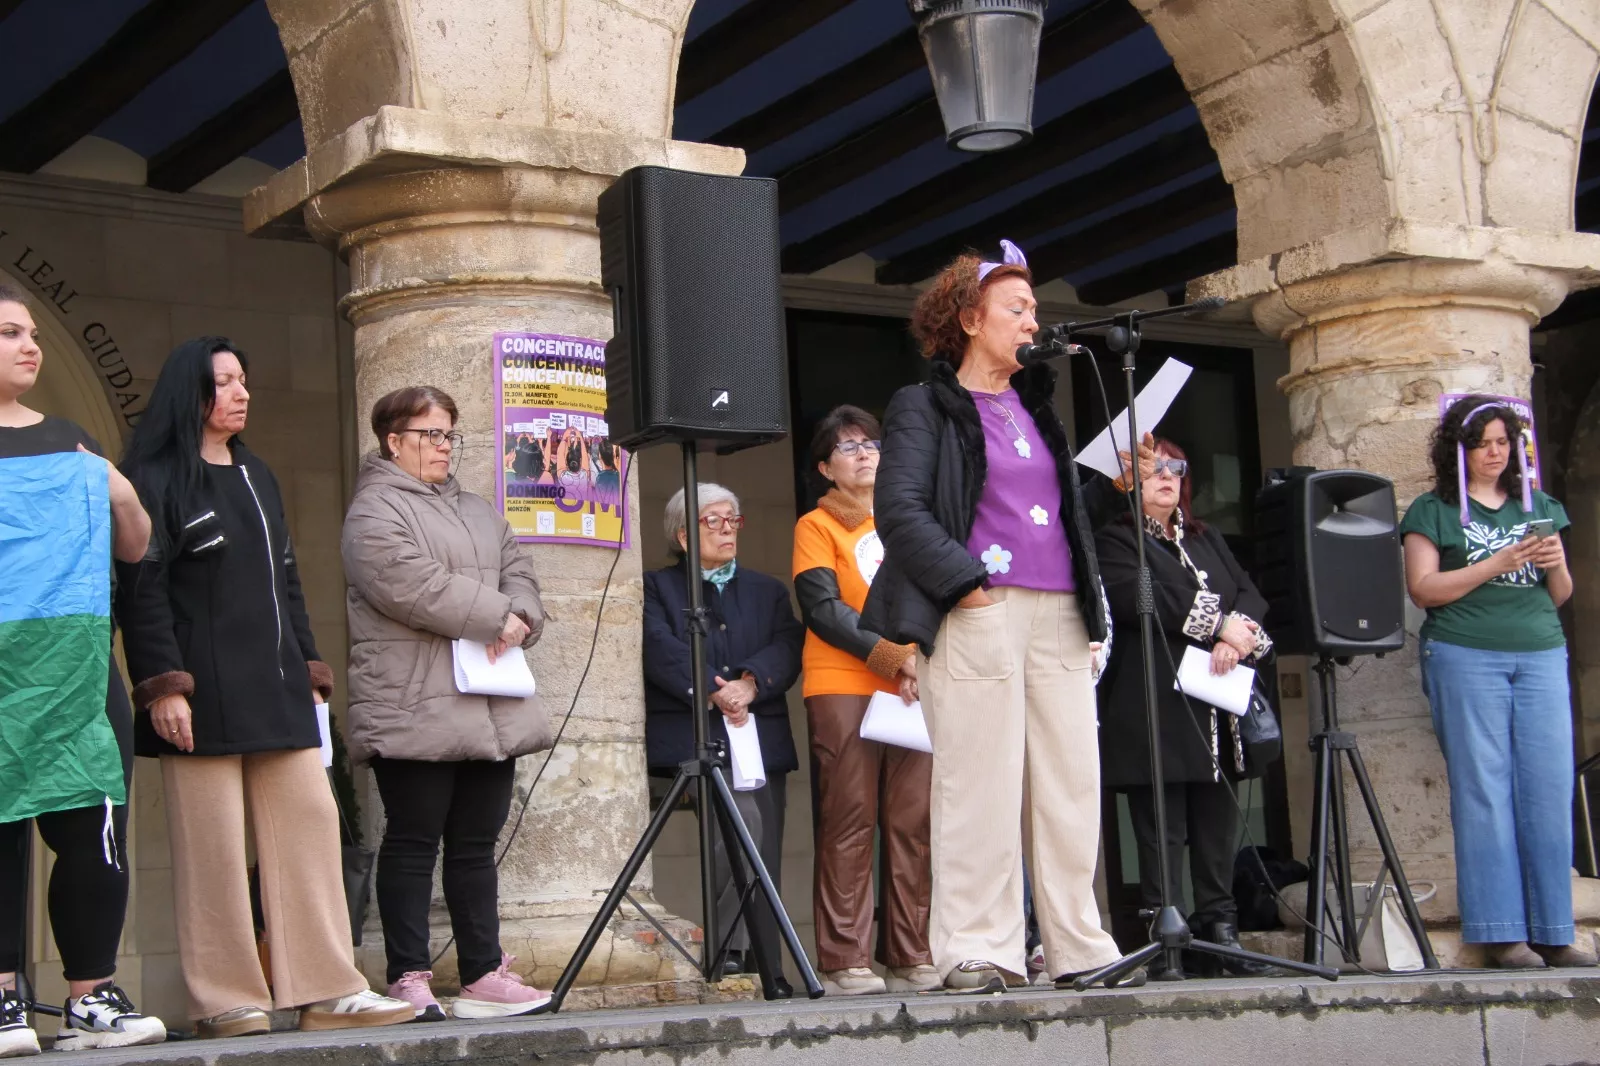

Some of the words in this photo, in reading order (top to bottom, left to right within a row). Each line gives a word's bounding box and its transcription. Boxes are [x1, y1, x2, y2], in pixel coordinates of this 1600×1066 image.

[13, 246, 79, 314] LEAL
[502, 338, 605, 362] CONCENTRACI
[503, 353, 606, 376] CONCENTRACI
[502, 367, 607, 391] CONCENTRACI
[506, 484, 566, 499] DOMINGO
